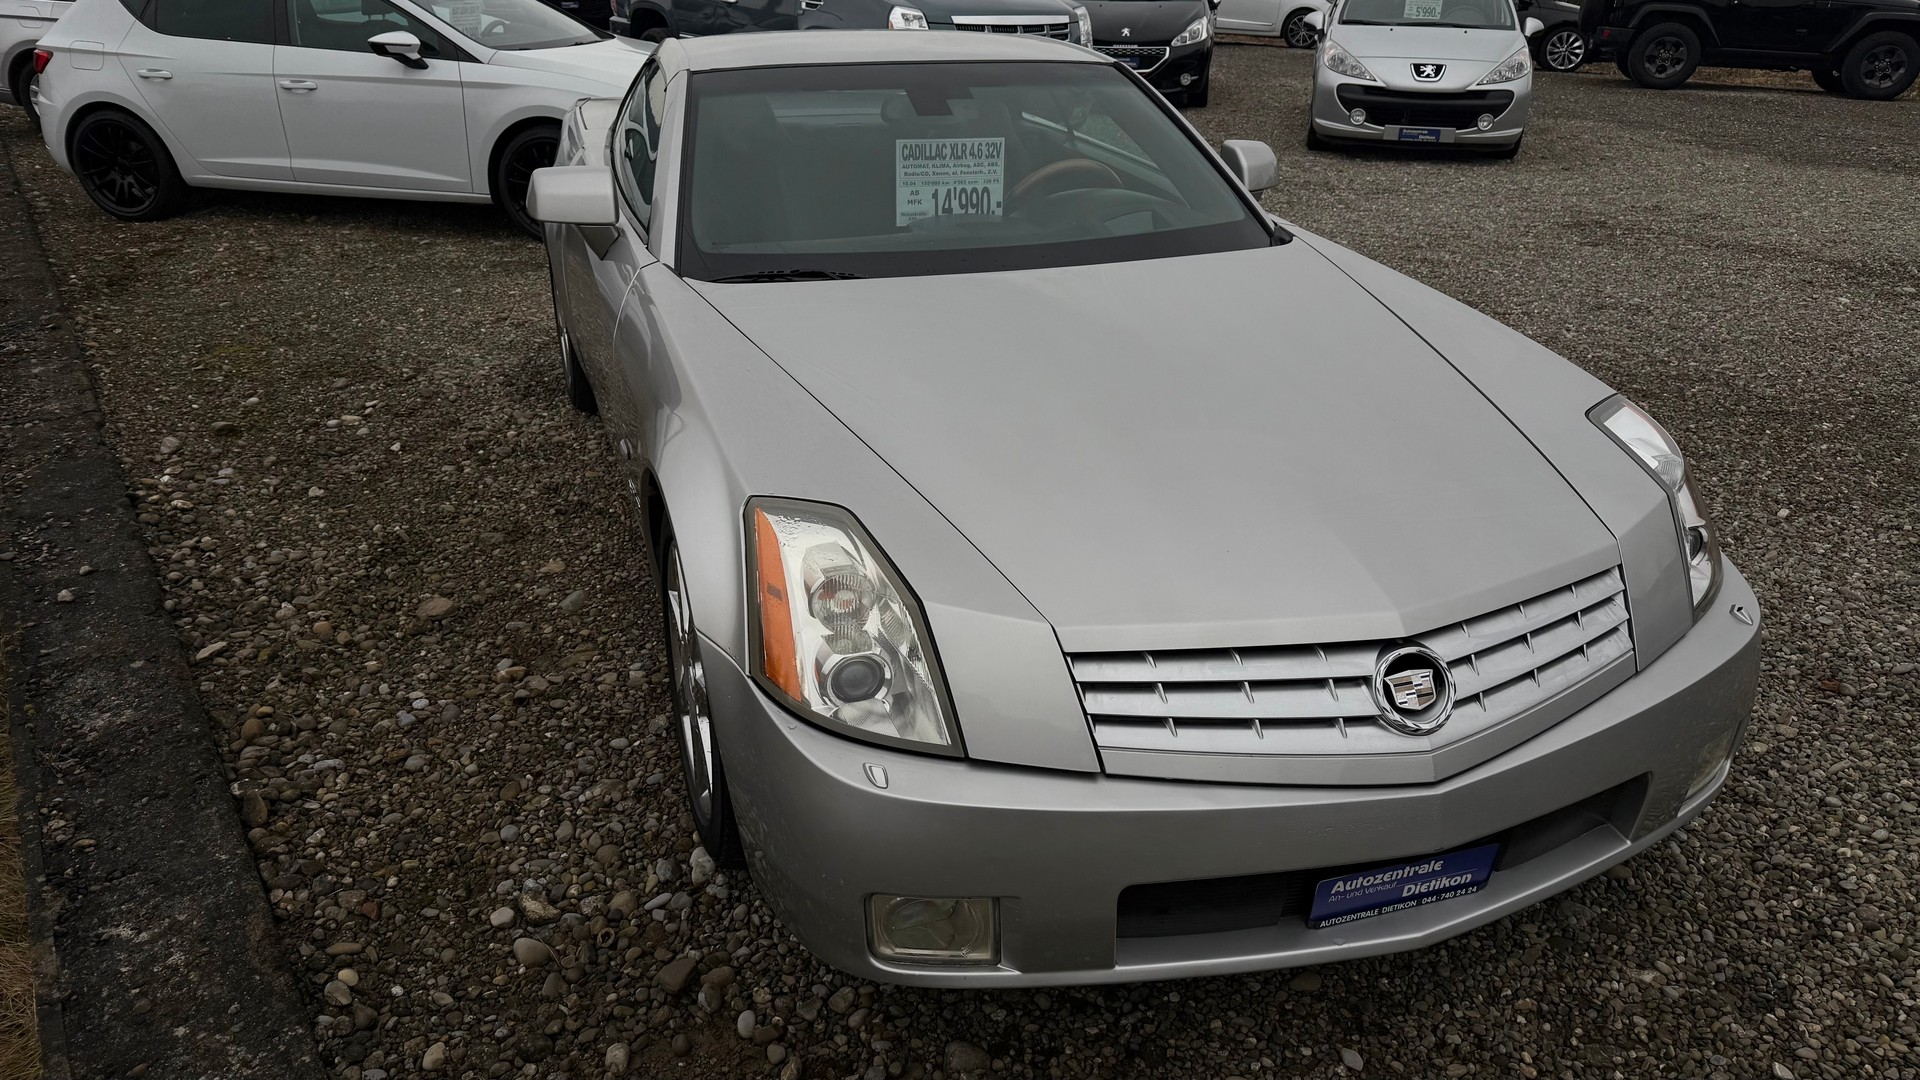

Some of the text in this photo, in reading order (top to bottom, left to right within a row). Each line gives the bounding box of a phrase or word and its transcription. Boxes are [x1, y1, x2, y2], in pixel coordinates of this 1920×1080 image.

[901, 142, 1002, 161] CADILLAC XLR 4.6 32V
[931, 186, 1002, 216] 14'990.-
[1330, 860, 1444, 894] Autozentrale
[1401, 873, 1473, 898] Dietikon
[1328, 881, 1397, 903] An- und Verkauf
[1319, 908, 1379, 928] AUTOZENTRALE
[1381, 900, 1417, 914] DIETIKON
[1456, 889, 1467, 897] 24
[1467, 886, 1478, 894] 24
